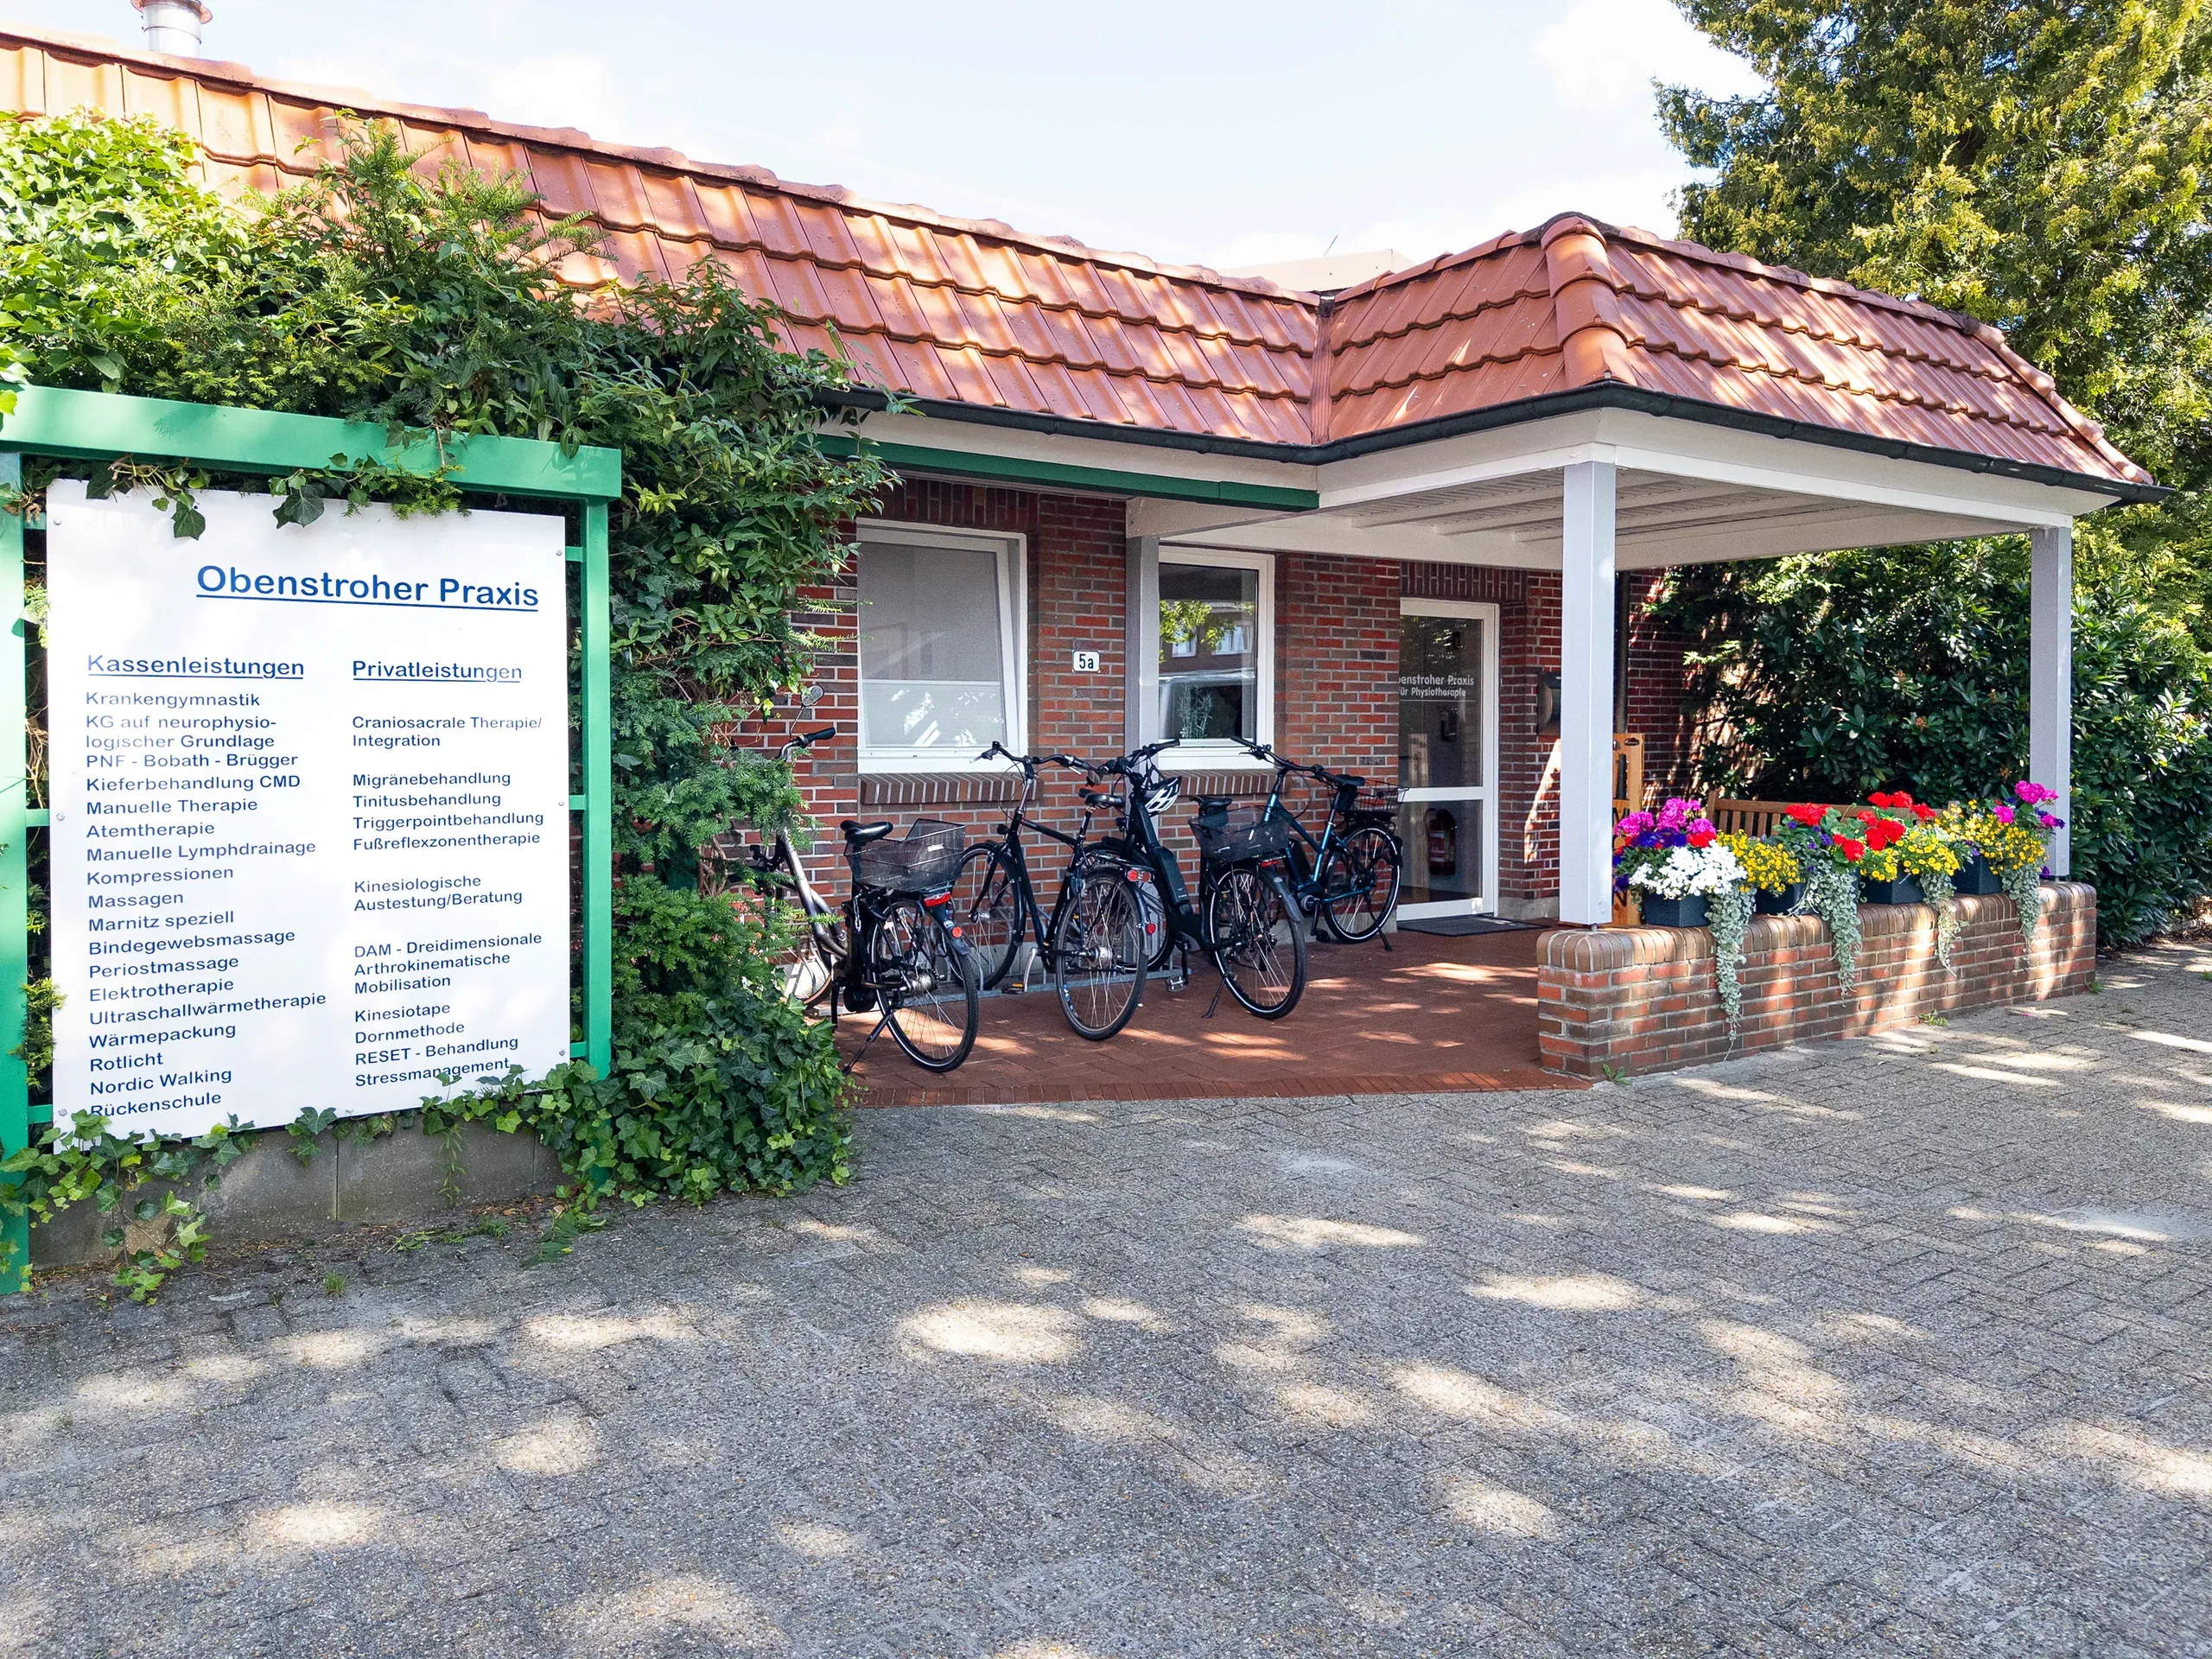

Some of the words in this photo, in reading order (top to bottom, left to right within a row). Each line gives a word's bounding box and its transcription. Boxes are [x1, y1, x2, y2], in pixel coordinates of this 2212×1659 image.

[197, 564, 429, 602] Obenstroher
[439, 577, 539, 607] Praxis
[87, 654, 304, 678] Kassenleistungen
[1078, 653, 1094, 669] 5a
[353, 660, 522, 683] Privatleistungen
[1447, 675, 1475, 686] Praxis
[86, 691, 261, 709] Krankengymnastik
[1398, 687, 1408, 696] ür
[1411, 687, 1466, 698] Physiotherapie
[86, 715, 114, 728] KG
[120, 715, 150, 728] auf
[158, 715, 277, 732] neurophysio-
[352, 715, 466, 729] Craniosacrale
[469, 716, 543, 732] Therapie/
[86, 734, 175, 752] logischer
[180, 734, 275, 751] Grundlage
[353, 734, 441, 750] Integration
[86, 754, 125, 768] PNF
[143, 753, 210, 767] Bobath
[226, 753, 299, 770] Brügger
[86, 776, 254, 792] Kieferbehandlung
[259, 774, 301, 789] CMD
[353, 772, 511, 790] Migränebehandlung
[86, 800, 172, 816] Manuelle
[177, 798, 258, 815] Therapie
[352, 792, 501, 808] Tinitusbehandlung
[86, 822, 215, 839] Atemtherapie
[352, 811, 543, 832] Triggerpointbehandlung
[353, 831, 541, 851] Fußreflexzonentherapie
[86, 845, 173, 862] Manuelle
[178, 841, 316, 861] Lymphdrainage
[86, 868, 233, 887] Kompressionen
[354, 874, 481, 893] Kinesiologische
[88, 893, 184, 909] Massagen
[353, 891, 523, 912] Austestung/Beratung
[88, 915, 160, 932] Marnitz
[164, 910, 234, 931] speziell
[89, 931, 296, 956] Bindegewebsmassage
[354, 943, 391, 958] DAM
[406, 932, 543, 955] Dreidimensionale
[89, 957, 239, 979] Periostmassage
[353, 952, 511, 976] Arthrokinematische
[89, 978, 234, 1002] Elektrotherapie
[354, 976, 451, 995] Mobilisation
[89, 992, 327, 1026] Ultraschallwärmetherapie
[354, 1004, 451, 1023] Kinesiotape
[88, 1025, 236, 1049] Wärmepackung
[355, 1021, 465, 1045] Dornmethode
[90, 1052, 164, 1072] Rotlicht
[355, 1047, 412, 1066] RESET
[425, 1038, 518, 1058] Behandlung
[90, 1077, 155, 1096] Nordic
[159, 1069, 232, 1088] Walking
[90, 1091, 222, 1117] Rückenschule
